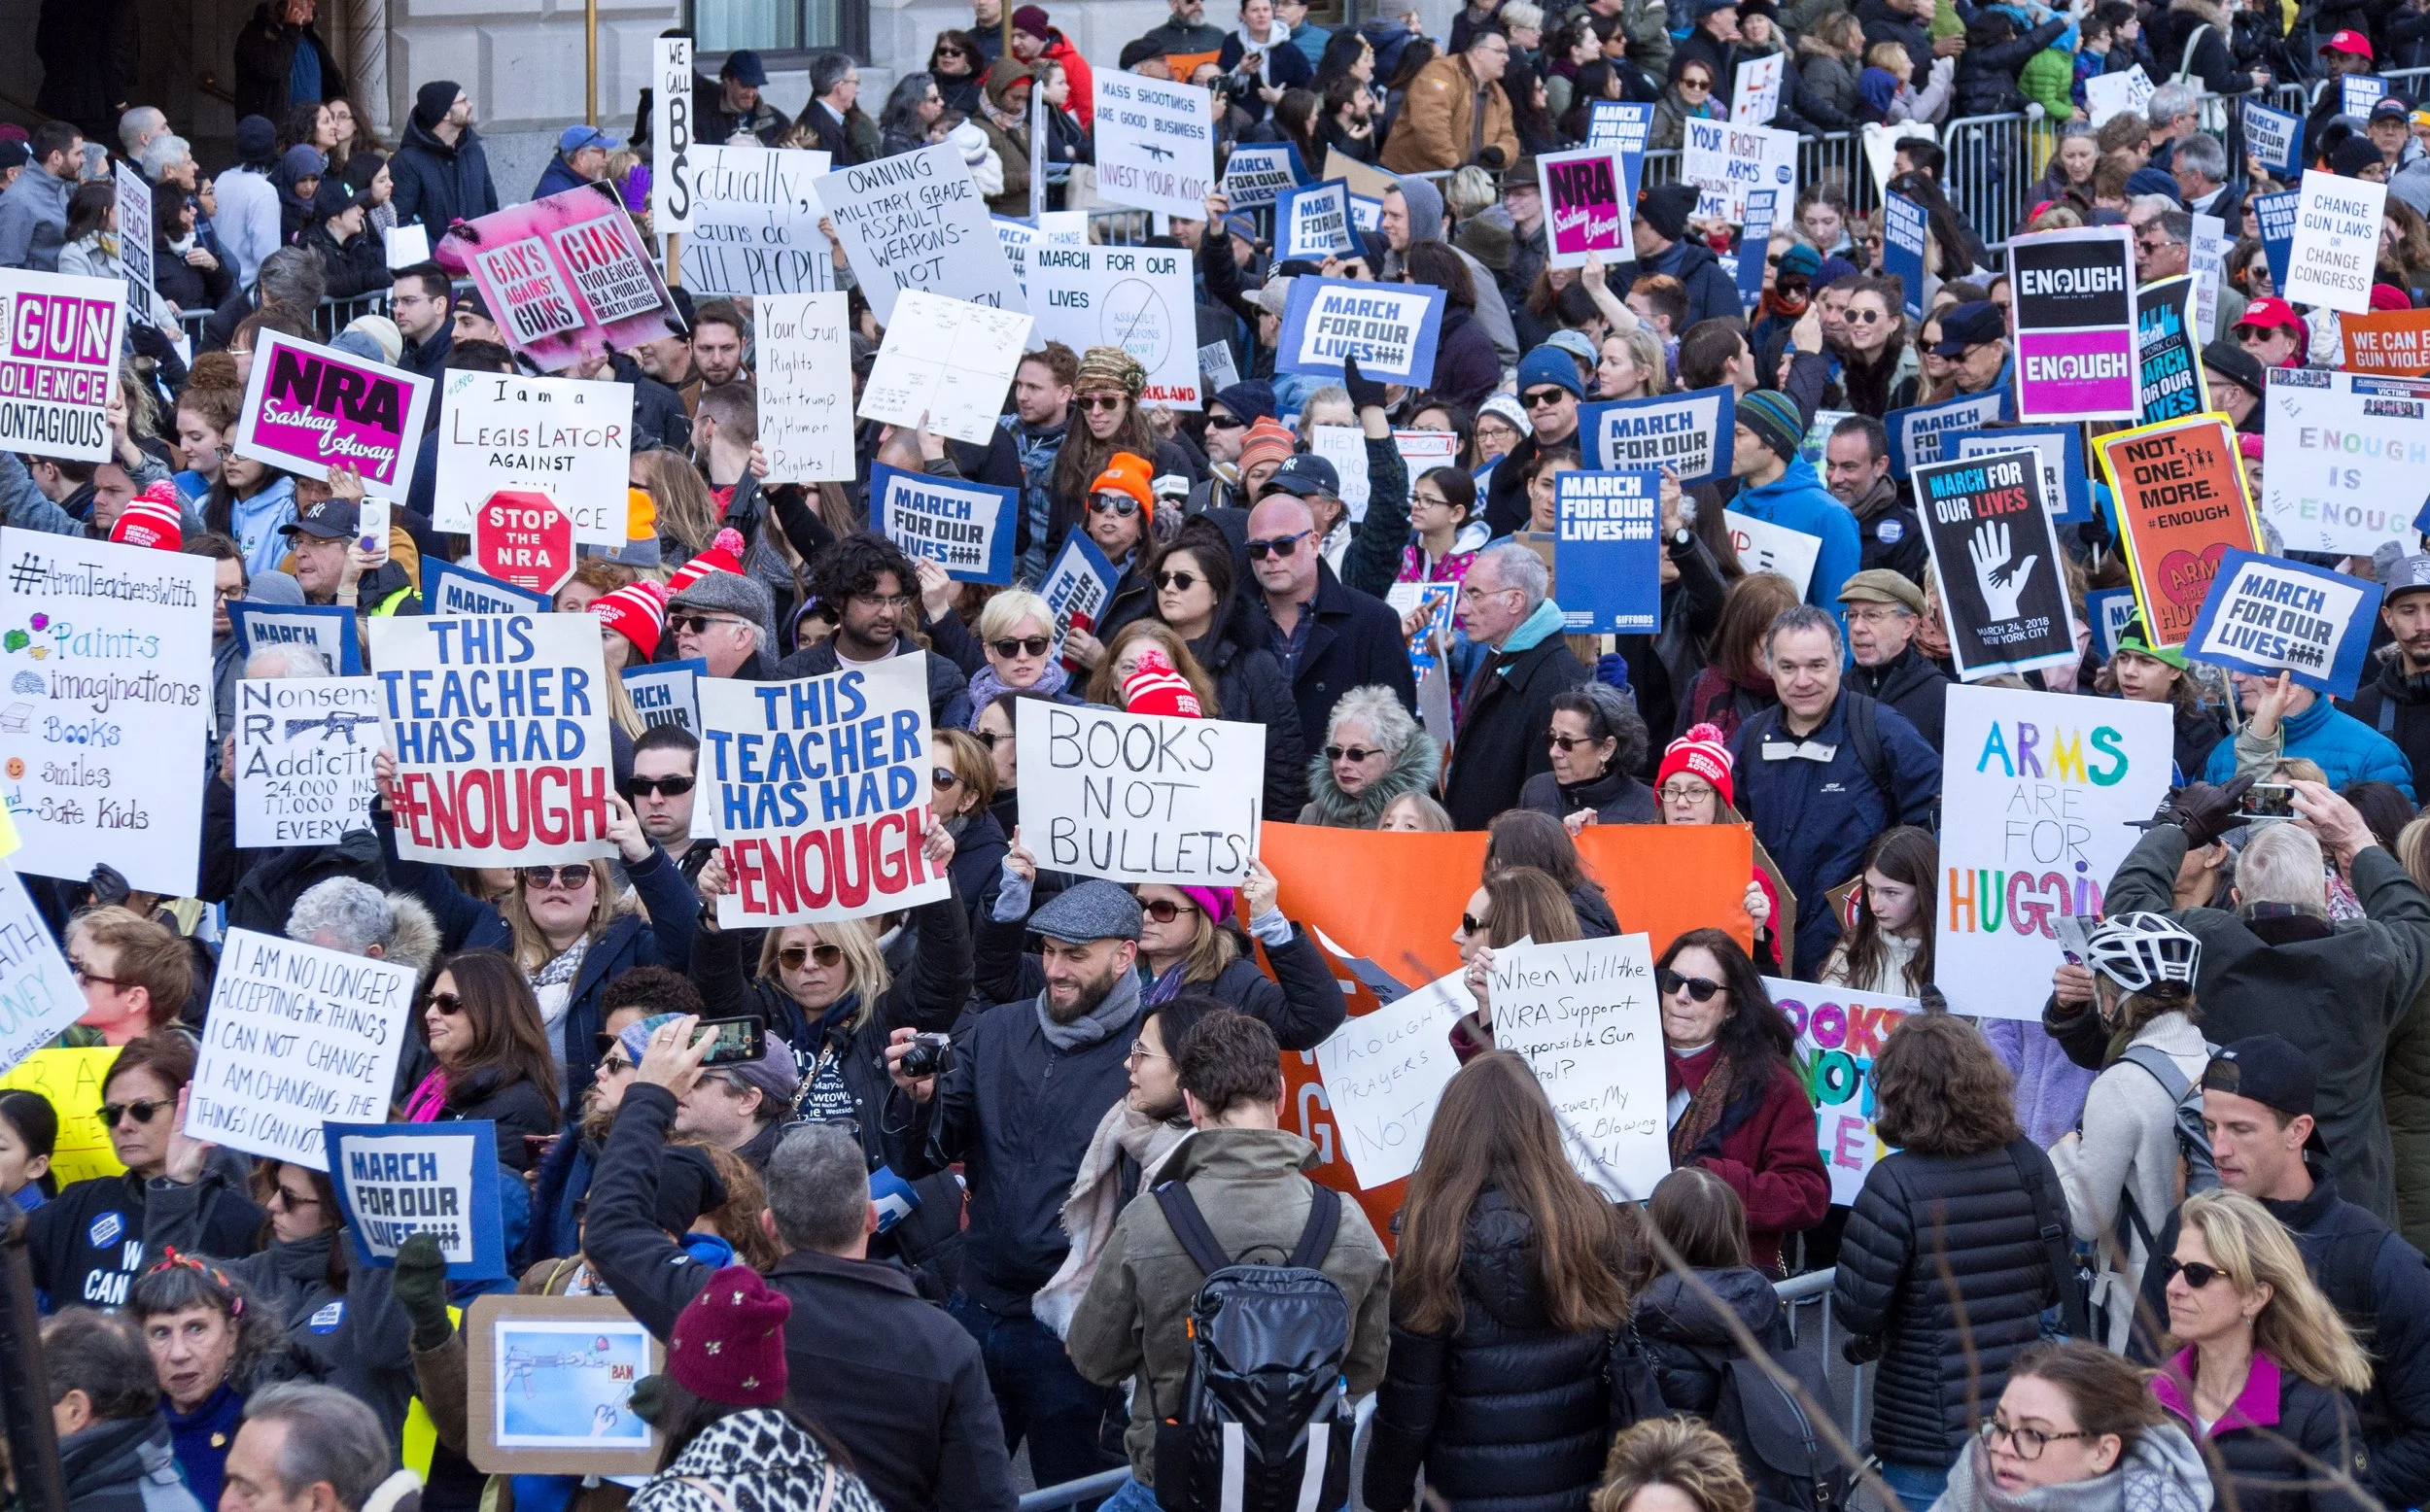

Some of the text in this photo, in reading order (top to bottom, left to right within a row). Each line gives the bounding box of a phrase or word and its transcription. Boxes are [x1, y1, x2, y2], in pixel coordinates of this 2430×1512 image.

[670, 43, 684, 64] WE
[667, 72, 690, 94] CALL
[1103, 82, 1196, 113] MASS SHOOTINGS
[1096, 105, 1204, 139] ARE GOOD BUSINESS
[1594, 106, 1642, 120] MARCH
[1591, 122, 1647, 137] FOR OUR
[1691, 123, 1767, 159] YOUR RIGHT
[849, 152, 933, 192] OWNING
[1100, 160, 1174, 197] INVEST YOUR
[1228, 157, 1274, 172] MARCH
[1258, 171, 1290, 186] OUR
[1726, 160, 1759, 183] ARMS
[1549, 161, 1616, 209] NRA
[834, 181, 972, 224] MILITARY GRADE
[2314, 194, 2370, 219] CHANGE
[763, 210, 790, 245] do
[860, 204, 942, 243] ASSAULT
[1554, 205, 1590, 238] Sashay
[1587, 215, 1619, 245] Away
[2305, 214, 2373, 239] GUN LAWS
[561, 220, 632, 273] GUN
[2330, 237, 2341, 247] OR
[487, 244, 546, 285] GAYS
[894, 257, 945, 290] NOT
[1039, 250, 1176, 274] MARCH FOR OUR
[2307, 247, 2360, 270] CHANGE
[578, 258, 642, 291] VIOLENCE
[2021, 266, 2123, 294] ENOUGH
[2295, 265, 2365, 292] CONGRESS
[505, 275, 556, 306] AGAINST
[587, 278, 650, 307] IS A PUBLIC
[595, 292, 657, 320] HEALTH CRISIS
[1049, 289, 1089, 309] LIVES
[514, 296, 573, 337] GUNS
[763, 302, 839, 342] Your Gun
[1323, 295, 1400, 321] MARCH
[17, 299, 110, 359] GUN
[1318, 317, 1408, 345] FOR OUR
[2166, 333, 2181, 346] CITY
[2352, 332, 2419, 351] WE CAN
[771, 351, 813, 384] Rights
[2027, 353, 2128, 381] ENOUGH
[2355, 352, 2385, 367] GUN
[270, 350, 399, 434] NRA
[496, 380, 507, 401] I
[2378, 389, 2411, 397] VICTIMS
[263, 399, 337, 449] Sashay
[454, 408, 621, 448] LEGISLATOR
[1612, 410, 1693, 438] MARCH
[320, 434, 394, 478] Away
[1613, 436, 1657, 460] FOR
[2125, 436, 2185, 463] NOT.
[2300, 427, 2427, 464] ENOUGH
[490, 455, 574, 470] AGAINST
[2329, 466, 2362, 490] IS
[1561, 477, 1642, 497] MARCH
[1929, 462, 2023, 498] MARCH FOR
[2139, 480, 2219, 509] MORE.
[490, 507, 558, 529] STOP
[894, 488, 971, 521] MARCH
[1561, 498, 1654, 518] FOR OUR
[1935, 487, 2029, 524] OUR LIVES
[2148, 504, 2230, 530] #ENOUGH
[123, 535, 152, 547] ACTION
[125, 530, 156, 542] DEMAND
[127, 525, 150, 533] MOMS
[507, 533, 539, 544] THE
[940, 519, 983, 544] OUR
[1561, 521, 1623, 540] LIVES
[498, 548, 551, 567] NRA
[2239, 573, 2326, 614] MARCH
[1615, 615, 1653, 624] GIFFORDS
[1977, 626, 2004, 636] MARCH
[2026, 617, 2050, 630] 2018
[47, 622, 159, 660] Paints
[429, 615, 534, 666] THIS
[1983, 627, 2049, 645] NEW YORK CITY
[2217, 621, 2289, 661] LIVES
[377, 668, 591, 719] TEACHER
[755, 670, 866, 731] THIS
[245, 715, 275, 744] R
[396, 718, 585, 764] HAS HAD
[1051, 709, 1219, 773] BOOKS
[706, 709, 922, 784] TEACHER
[1976, 719, 2129, 785] ARMS
[37, 796, 149, 830] Safe Kids
[392, 767, 608, 850] #ENOUGH
[721, 765, 918, 830] HAS HAD
[1085, 775, 1199, 822] NOT
[2006, 784, 2085, 820] ARE
[276, 819, 349, 841] EVERY
[1051, 798, 1255, 877] BULLETS!
[2004, 819, 2094, 866] FOR
[723, 804, 946, 915] #ENOUGH
[234, 939, 400, 1009] I AM NO LONGER
[1493, 957, 1560, 992] When
[215, 978, 387, 1046] ACCEPTING THINGS
[1496, 996, 1641, 1030] NRA Support
[210, 1017, 380, 1083] I CAN NOT CHANGE
[1600, 1025, 1635, 1046] Gun
[224, 1062, 377, 1117] AM CHANGING THE
[1602, 1085, 1629, 1110] My
[195, 1096, 323, 1154] THINGS CAN NOT
[1355, 1102, 1425, 1161] NOT
[1590, 1117, 1656, 1139] Blowing
[351, 1151, 437, 1183] MARCH
[401, 1186, 459, 1217] OUR
[84, 1269, 129, 1304] CAN
